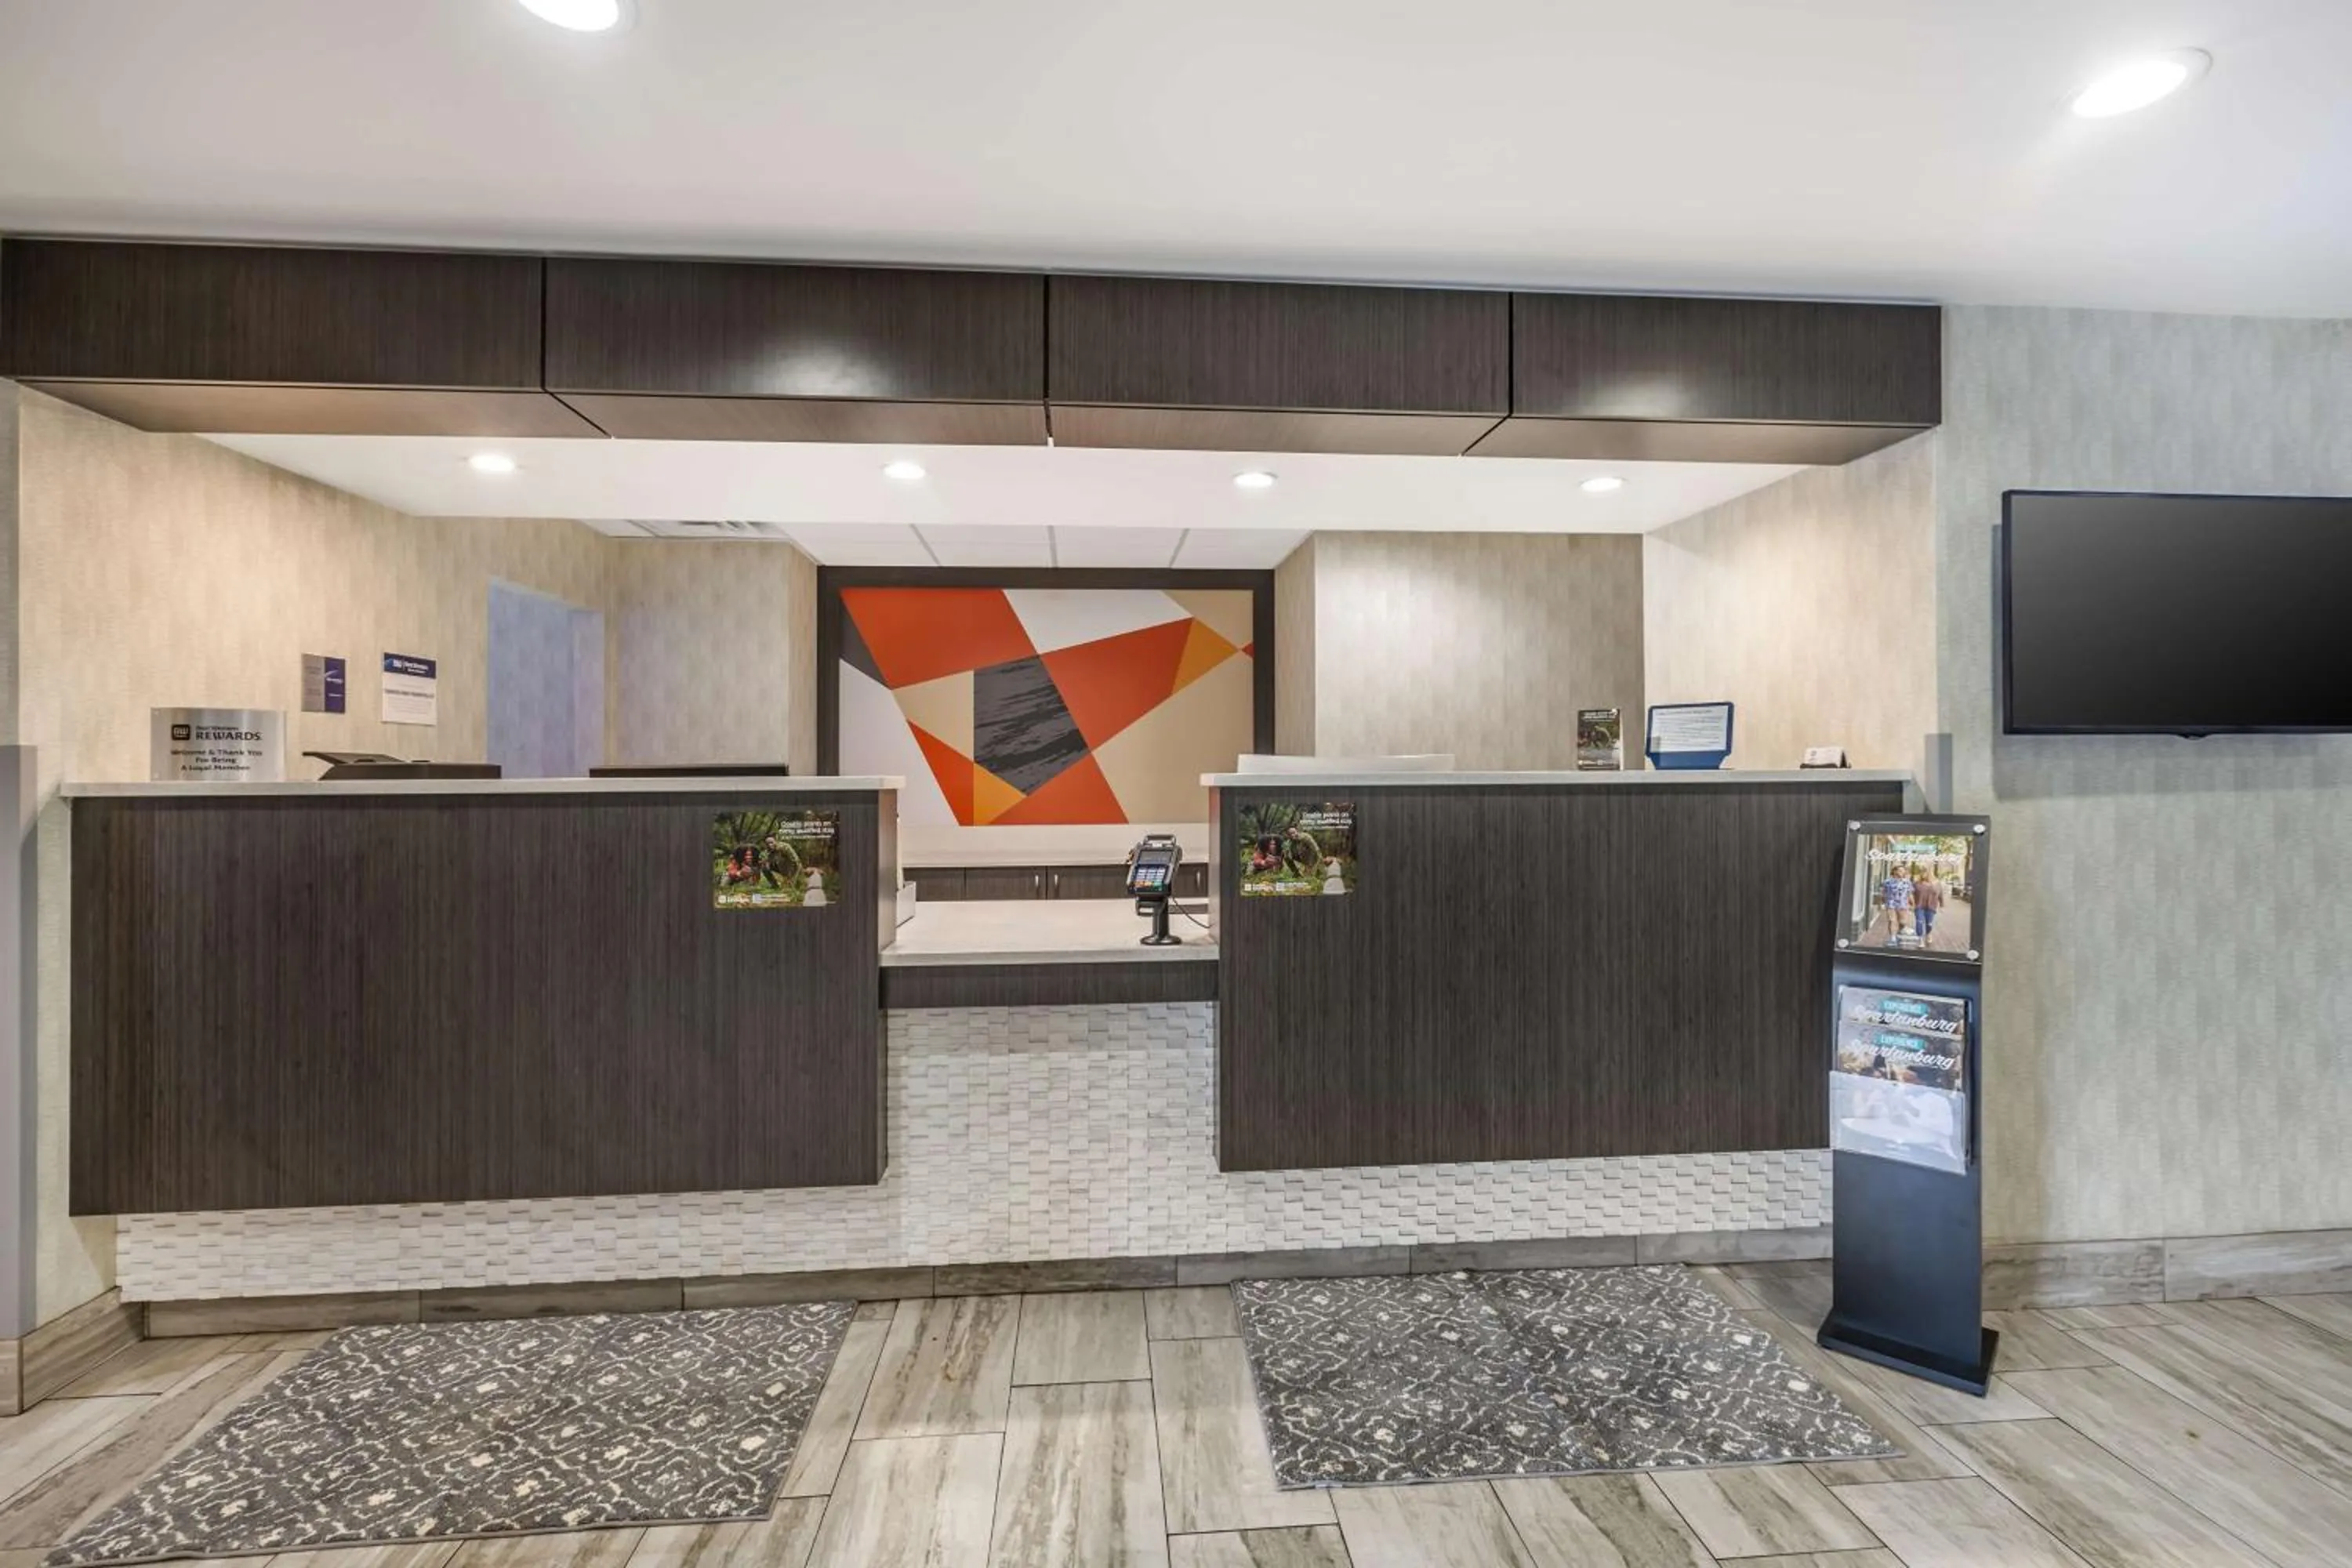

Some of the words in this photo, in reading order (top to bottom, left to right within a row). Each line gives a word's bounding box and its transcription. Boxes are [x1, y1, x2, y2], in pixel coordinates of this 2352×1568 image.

[196, 731, 262, 741] REWARDS
[1849, 1004, 1957, 1032] Spartanburg
[1845, 1039, 1955, 1069] Spartanburg
